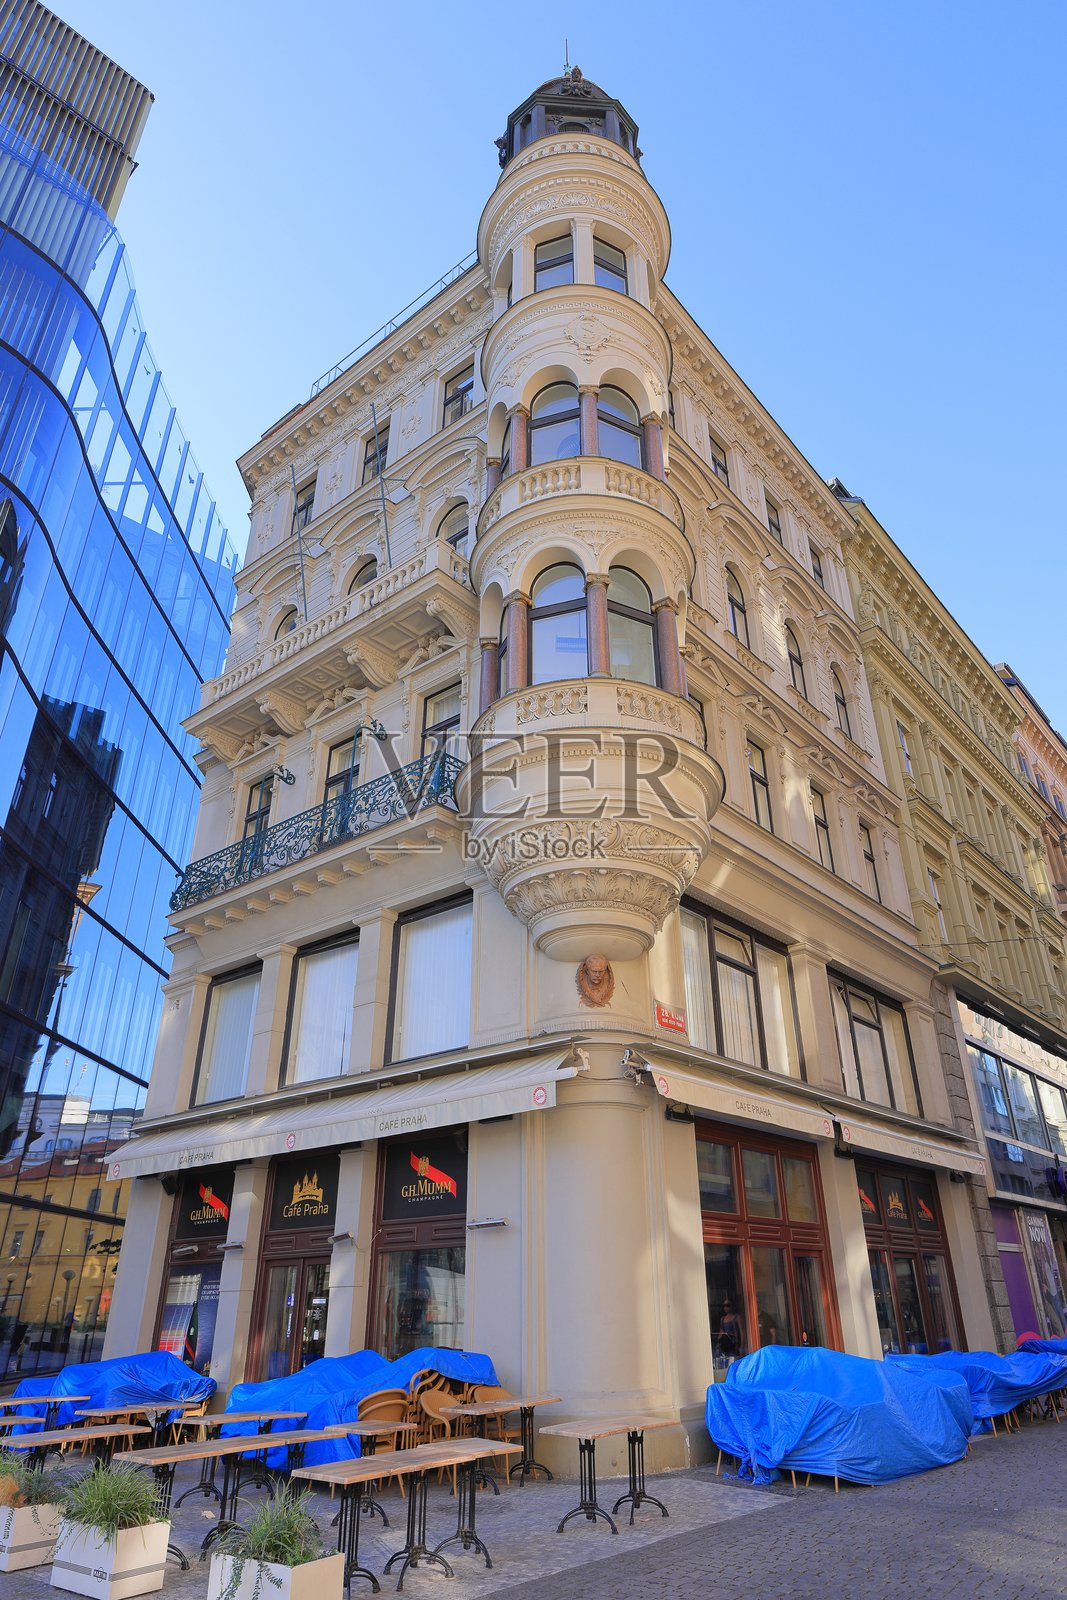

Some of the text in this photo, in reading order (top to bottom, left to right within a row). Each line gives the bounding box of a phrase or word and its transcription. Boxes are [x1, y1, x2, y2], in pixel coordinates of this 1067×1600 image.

[751, 1104, 772, 1118] PRAHA
[400, 1113, 428, 1128] PRAHA
[194, 1151, 214, 1162] PRAHA
[283, 1202, 329, 1218] Café Praha
[1028, 1226, 1047, 1243] NOW
